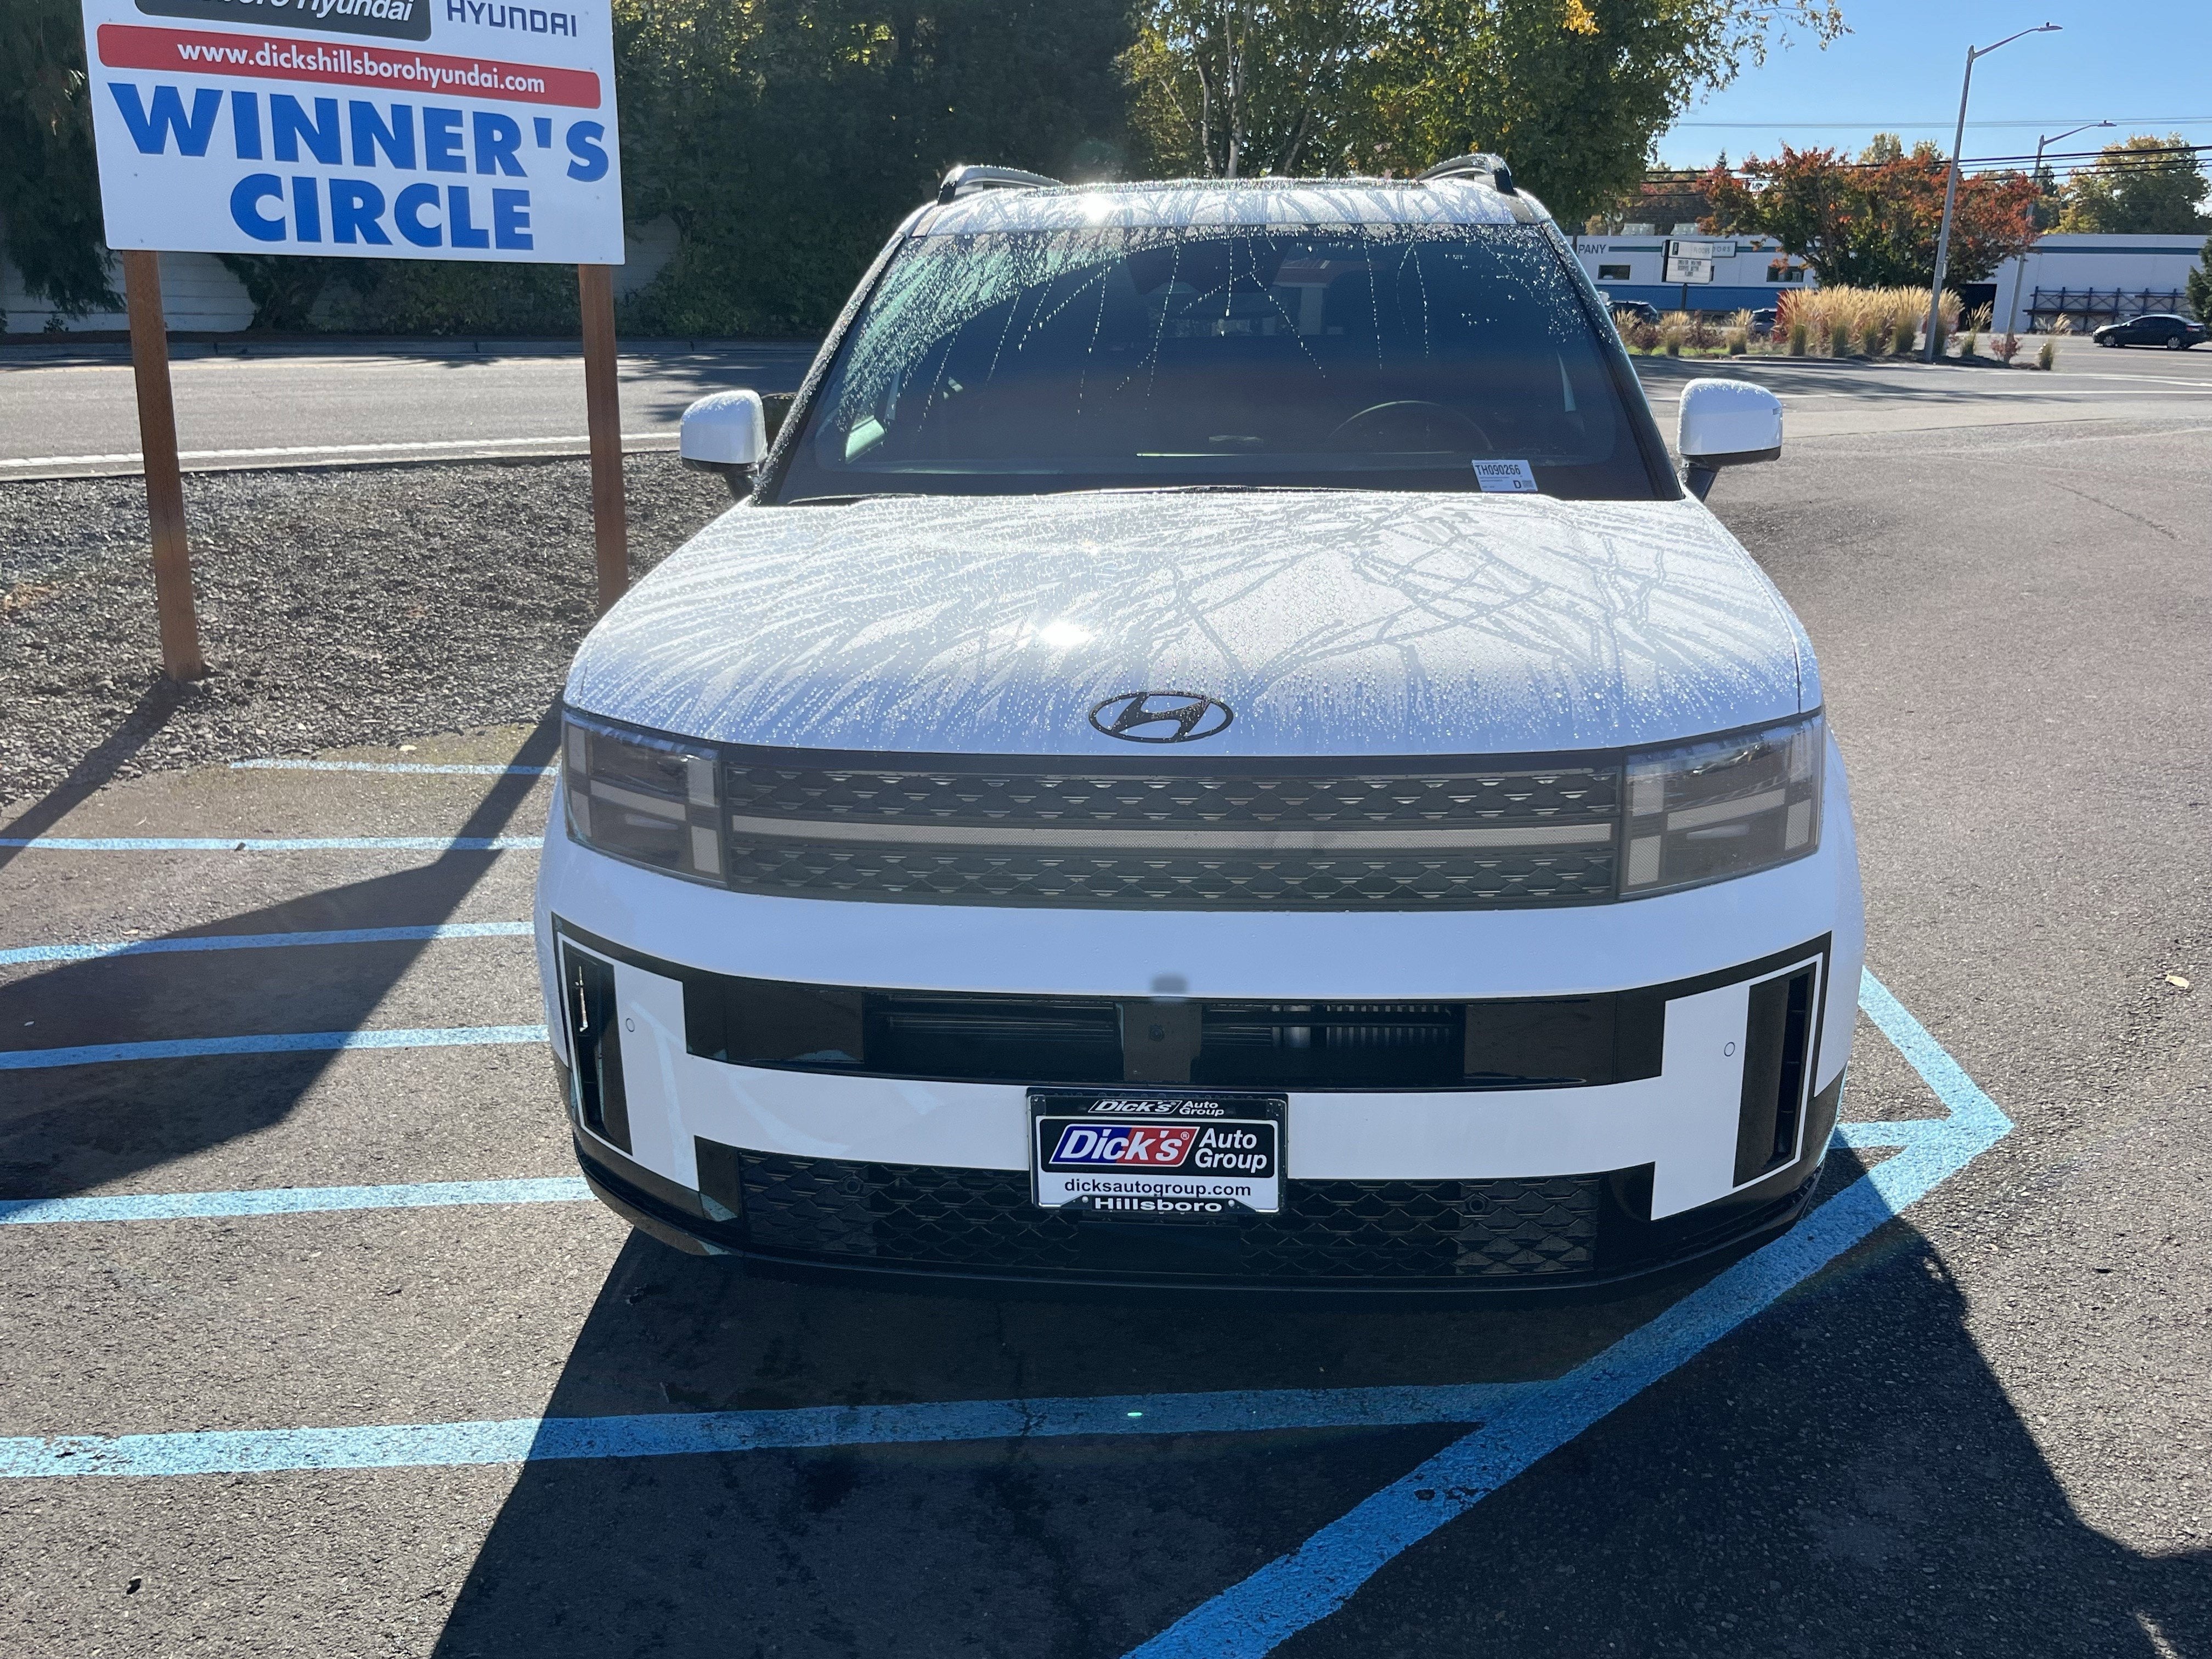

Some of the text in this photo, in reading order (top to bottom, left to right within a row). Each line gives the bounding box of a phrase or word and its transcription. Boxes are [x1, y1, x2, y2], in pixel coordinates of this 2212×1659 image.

[447, 0, 577, 37] HYUNDAI
[177, 42, 545, 94] www.dickshillsborohyundai.com
[108, 83, 609, 182] WINNER'S
[230, 173, 534, 250] CIRCLE
[1513, 480, 1522, 489] D
[1179, 1107, 1225, 1117] Group
[1182, 1101, 1218, 1109] Auto
[1199, 1128, 1257, 1149] Auto
[1195, 1147, 1267, 1173] Group
[1064, 1178, 1251, 1197] dicksautogroup.com
[1094, 1197, 1222, 1212] Hillsboro
